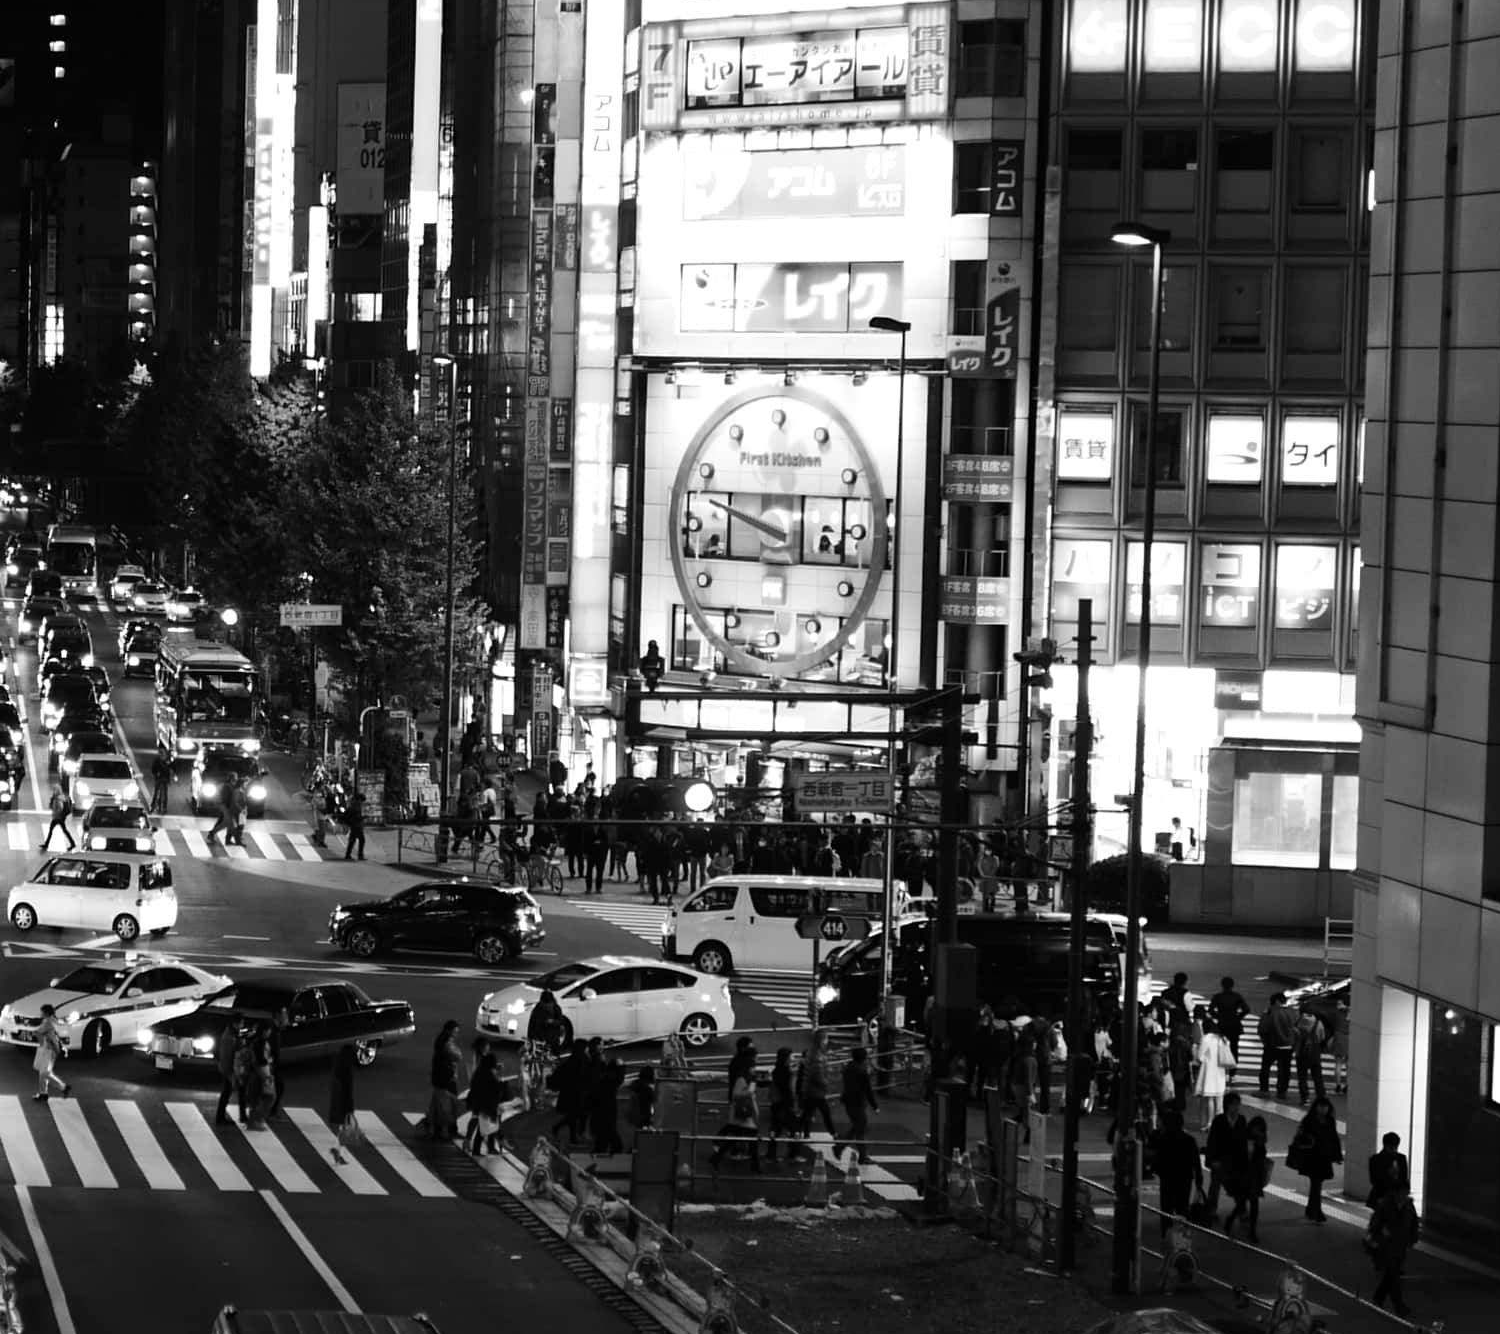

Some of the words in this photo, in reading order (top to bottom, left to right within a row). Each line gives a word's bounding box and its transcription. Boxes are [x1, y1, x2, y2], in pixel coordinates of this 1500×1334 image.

[910, 24, 947, 97] 賃貸
[766, 165, 837, 198] アコム
[995, 146, 1018, 212] アコム
[785, 272, 889, 320] レイク
[990, 305, 1013, 367] レイク
[950, 355, 982, 372] レイク
[739, 451, 769, 467] First
[771, 451, 822, 469] Kitchen
[1064, 439, 1108, 460] 賃貸
[527, 482, 545, 548] ソフマップ
[823, 922, 844, 935] 414
